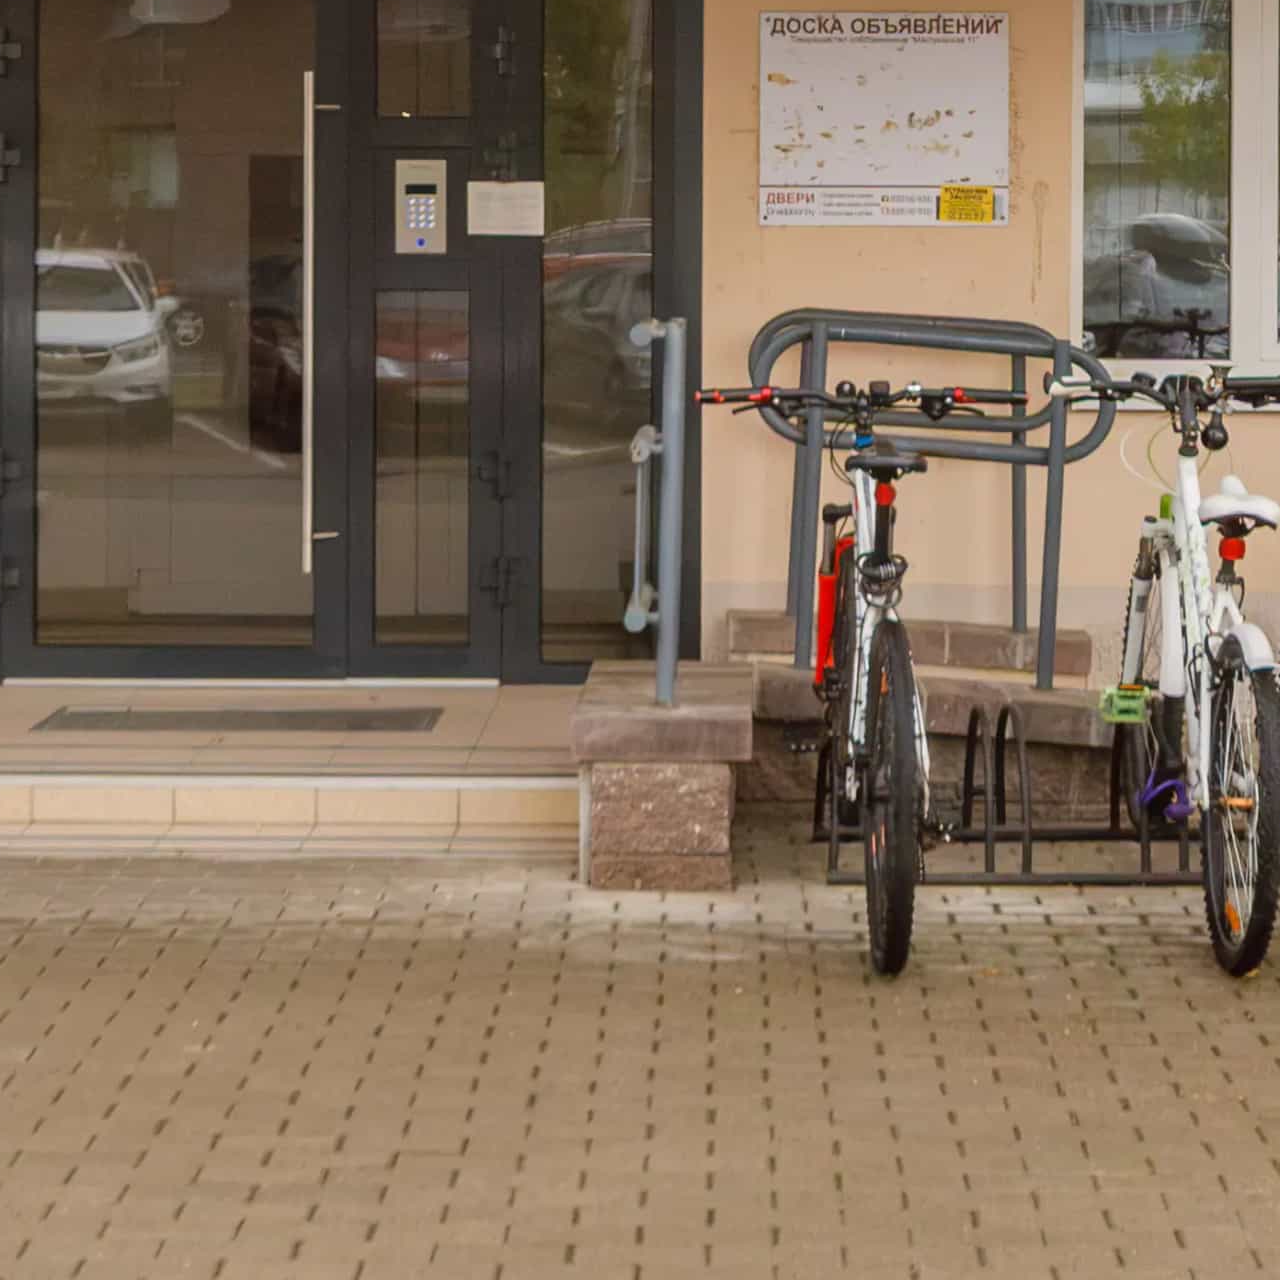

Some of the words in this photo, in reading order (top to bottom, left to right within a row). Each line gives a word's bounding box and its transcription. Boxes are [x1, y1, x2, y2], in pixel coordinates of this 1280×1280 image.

[770, 17, 844, 36] ДОСКА
[850, 15, 1001, 35] ОБЪЯВЛЕНИЙ
[766, 192, 816, 206] ДВЕРИ
